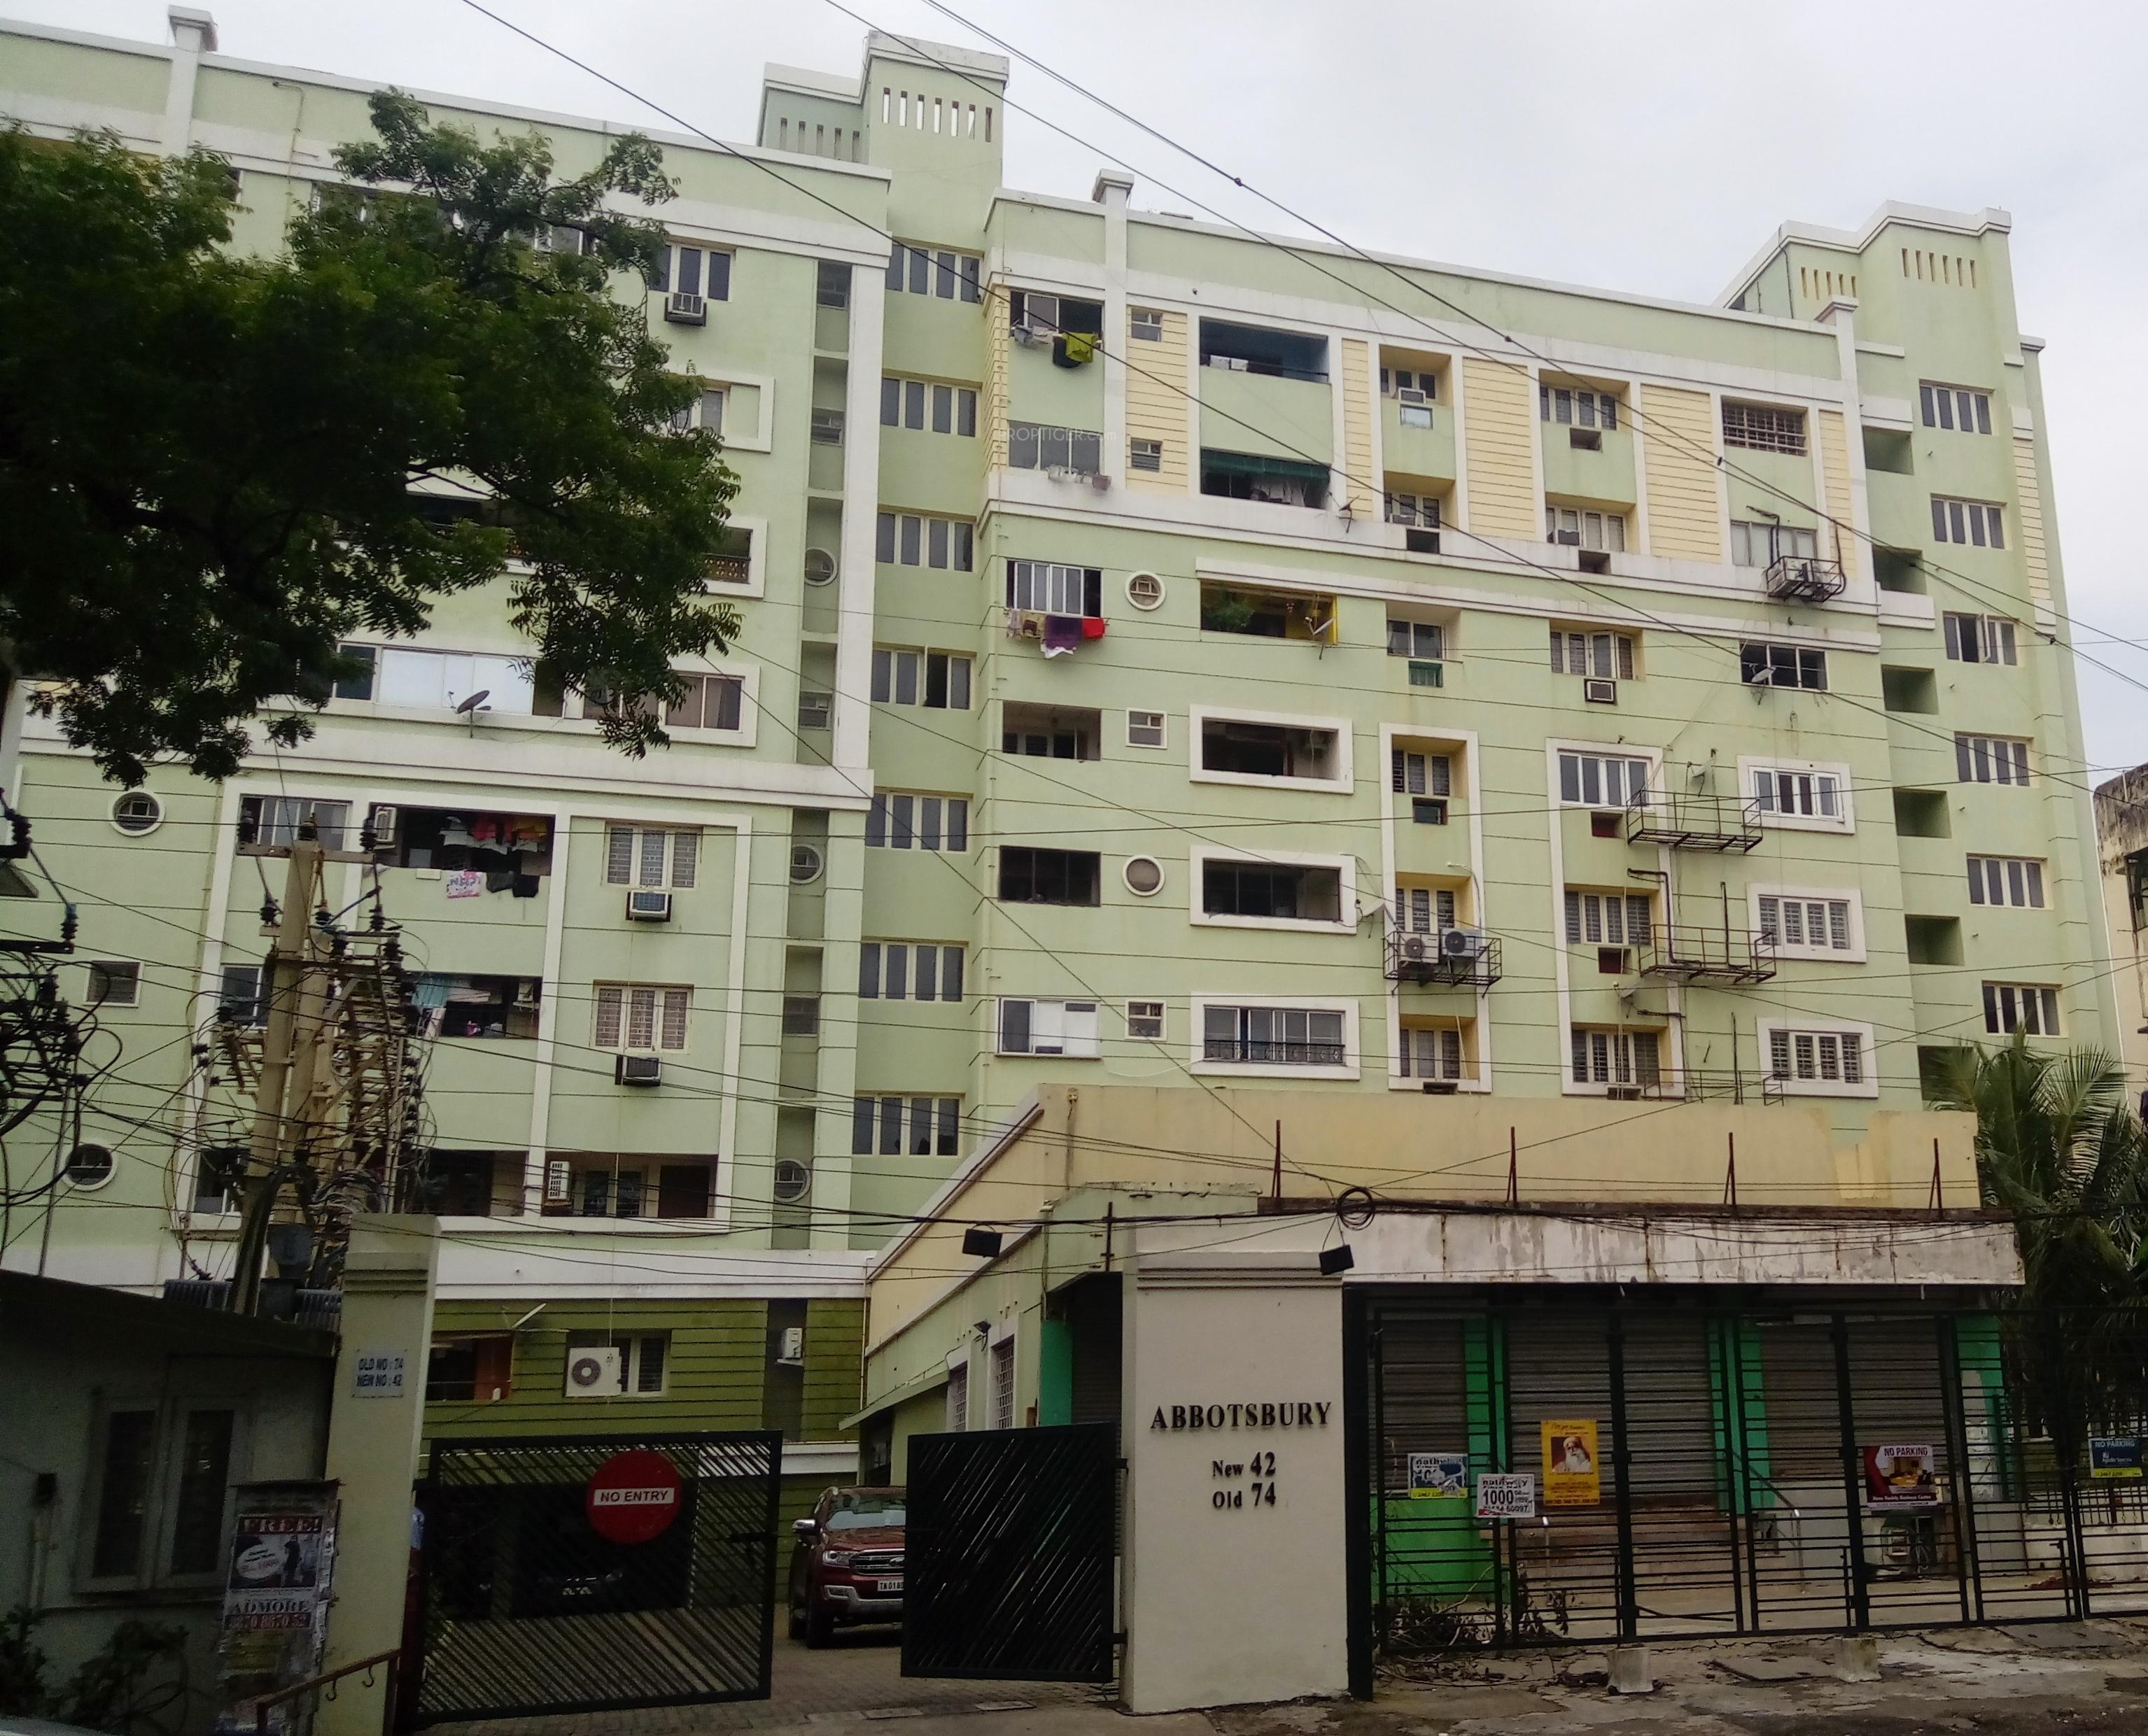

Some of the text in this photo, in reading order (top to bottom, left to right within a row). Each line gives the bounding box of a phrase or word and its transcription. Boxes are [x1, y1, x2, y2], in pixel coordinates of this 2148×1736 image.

[358, 1357, 374, 1370] OLD
[376, 1358, 388, 1370] NO
[394, 1357, 404, 1370] 74
[356, 1374, 375, 1387] NEW
[375, 1374, 387, 1387] NO
[392, 1374, 402, 1387] 42
[1150, 1402, 1332, 1430] ABBOTSBURY
[1884, 1447, 1928, 1456] NO PARKING
[1212, 1451, 1276, 1478] New 42
[601, 1490, 668, 1502] NO ENTRY
[1212, 1482, 1277, 1509] Old 74
[1483, 1489, 1514, 1505] 1000
[242, 1517, 320, 1532] FREE!
